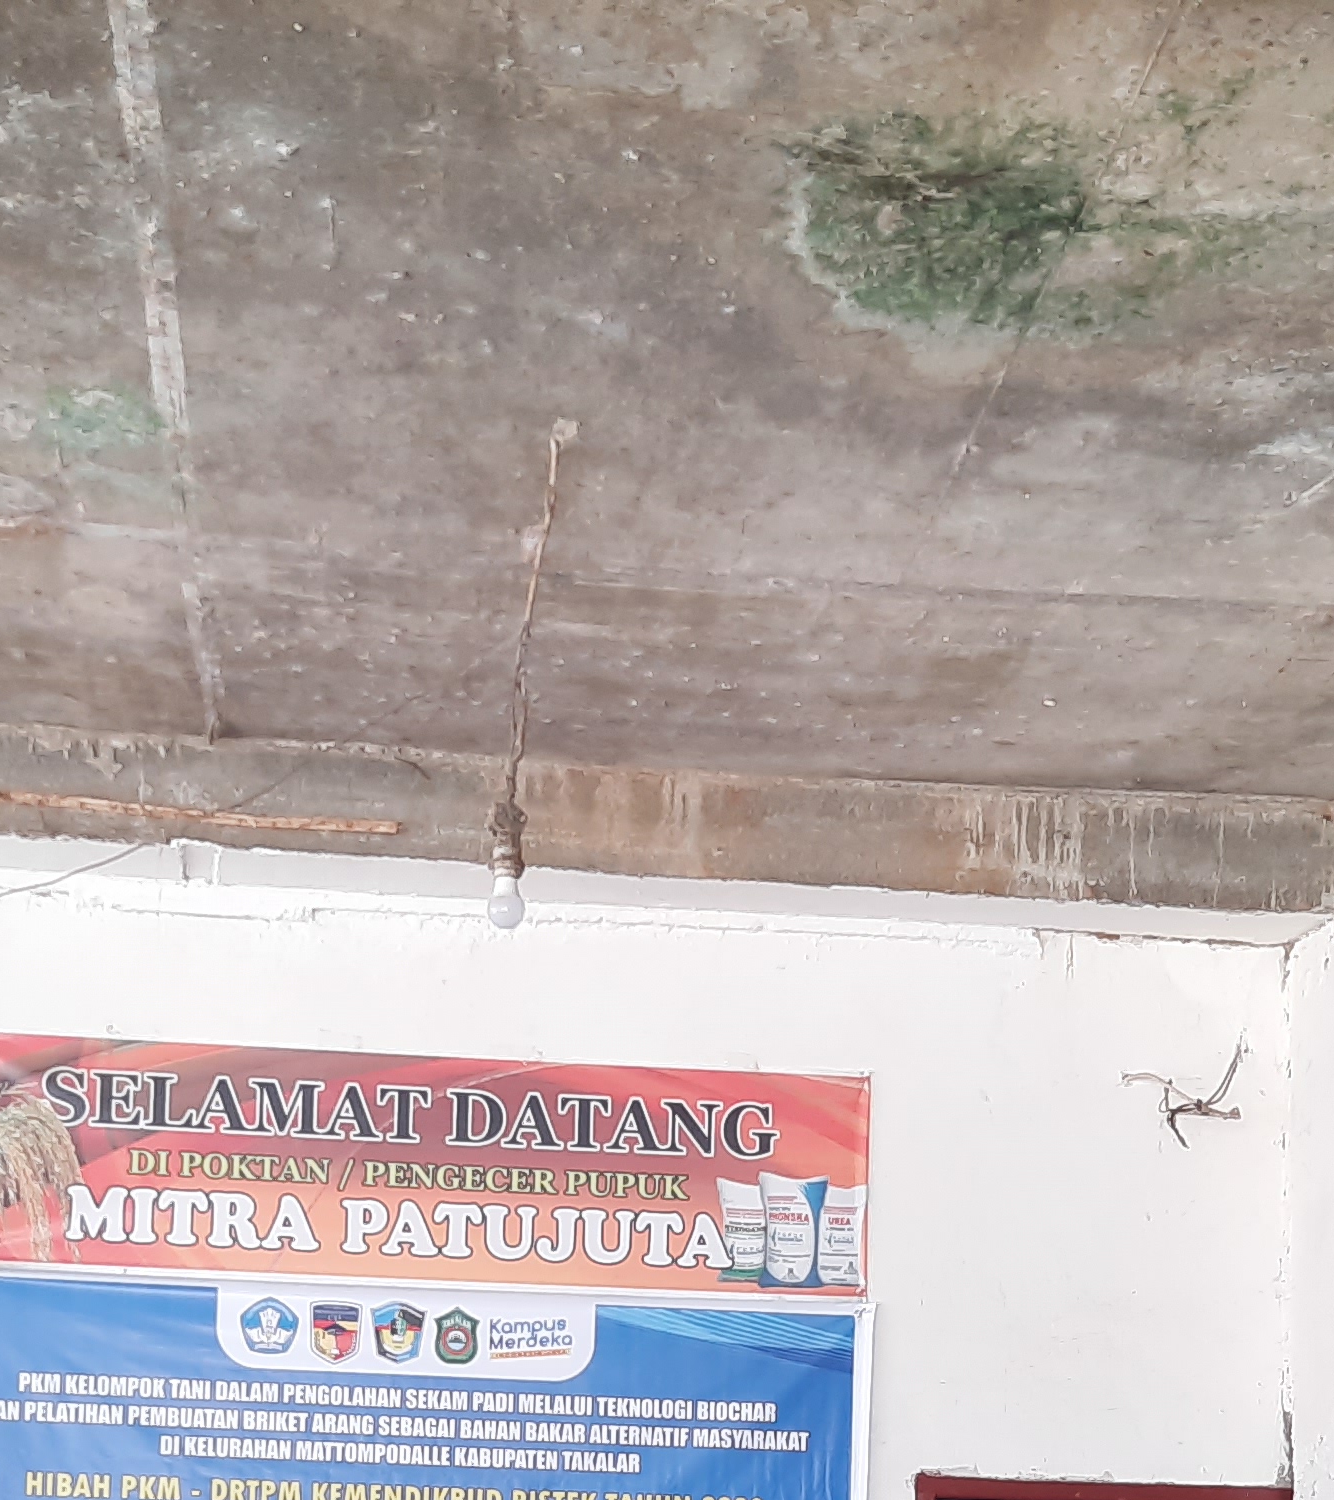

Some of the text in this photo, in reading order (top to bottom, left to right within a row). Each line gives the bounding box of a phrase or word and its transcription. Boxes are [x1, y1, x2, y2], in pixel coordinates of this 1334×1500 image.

[42, 1066, 780, 1160] SELAMAT DATANG
[129, 1149, 690, 1201] DI POKTAN / PENGECER PUPUK
[64, 1184, 734, 1269] MITRA PATUJUTA
[489, 1318, 567, 1335] Kampus
[489, 1332, 573, 1350] Merdeka
[19, 1372, 777, 1423] PKM KELOMPOK TANI DALAM PENGOLAHAN SEKAM PADI MELALUI TEKNOLOGI BIOCHAR
[24, 1402, 123, 1425] PELATIHAN
[128, 1405, 239, 1430] PEMBUATAN
[243, 1410, 308, 1432] BRIKET
[311, 1413, 374, 1435] ARANG
[378, 1415, 456, 1438] SEBAGAI
[460, 1419, 521, 1441] BAHAN
[525, 1422, 585, 1443] BAKAR
[589, 1424, 690, 1447] ALTERNATIF
[692, 1428, 810, 1451] MASYARAKAT
[159, 1435, 641, 1473] DI KELURAHAN MATTOMPODALLE KABUPATEN TAKALAR
[25, 1471, 111, 1498] HIBAH
[120, 1474, 181, 1500] PKM
